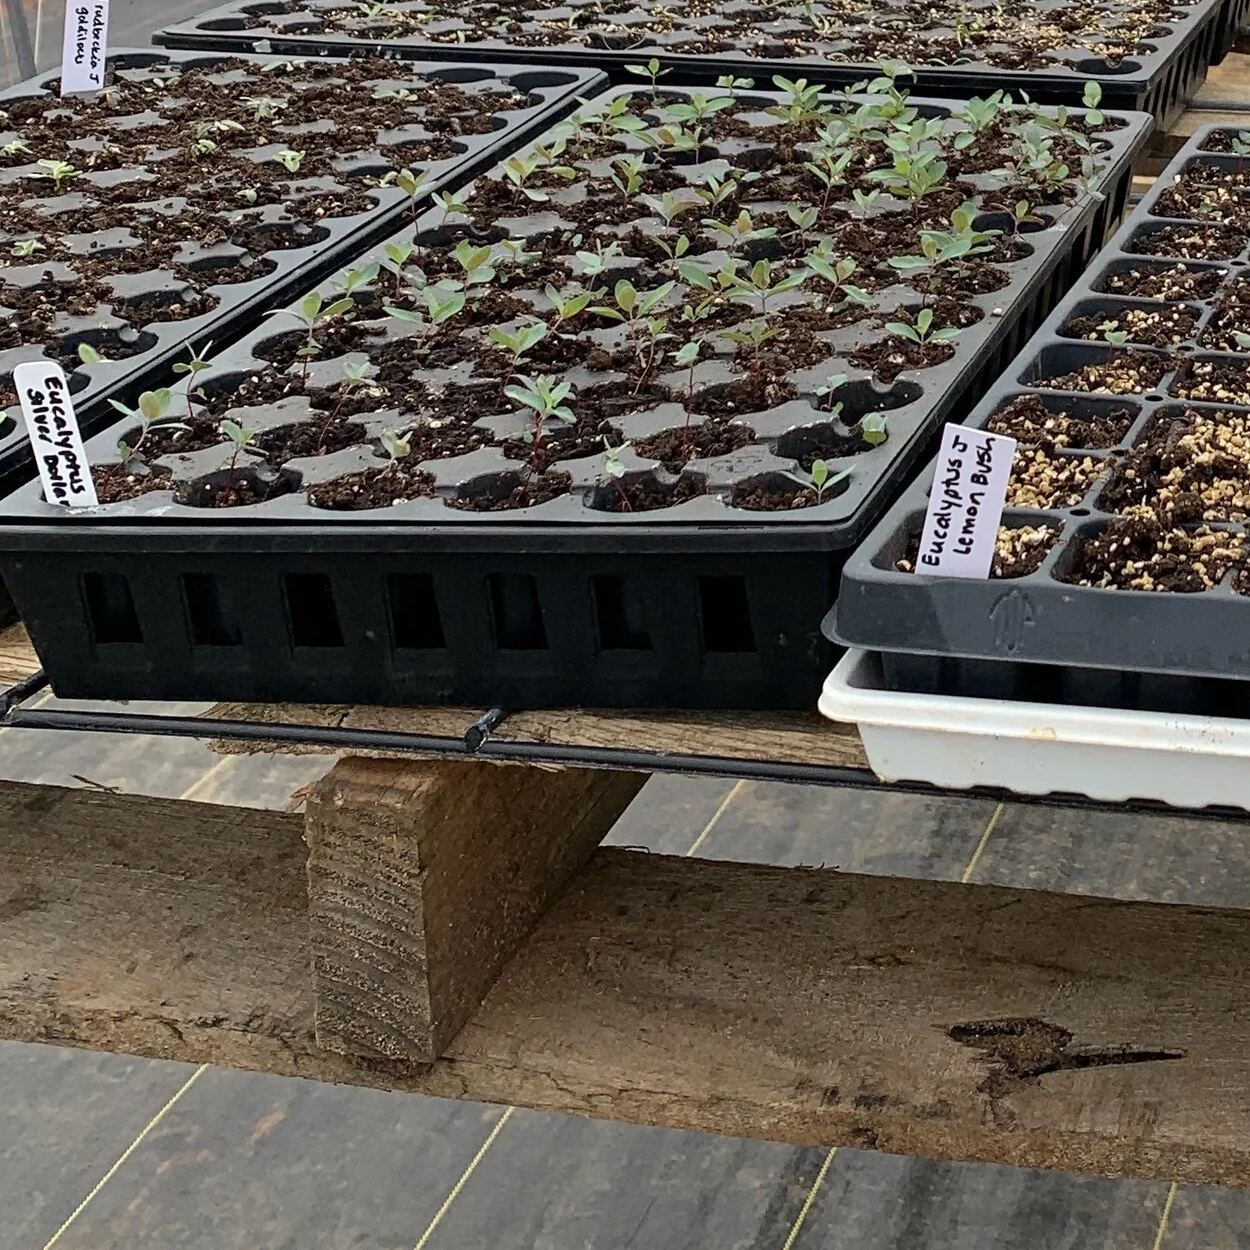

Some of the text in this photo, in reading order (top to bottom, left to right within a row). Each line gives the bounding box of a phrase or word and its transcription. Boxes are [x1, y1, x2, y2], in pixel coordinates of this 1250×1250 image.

[45, 376, 86, 494] Eucalyptus
[921, 459, 963, 566] Eucalyptus
[953, 438, 996, 555] Lemon Bush
